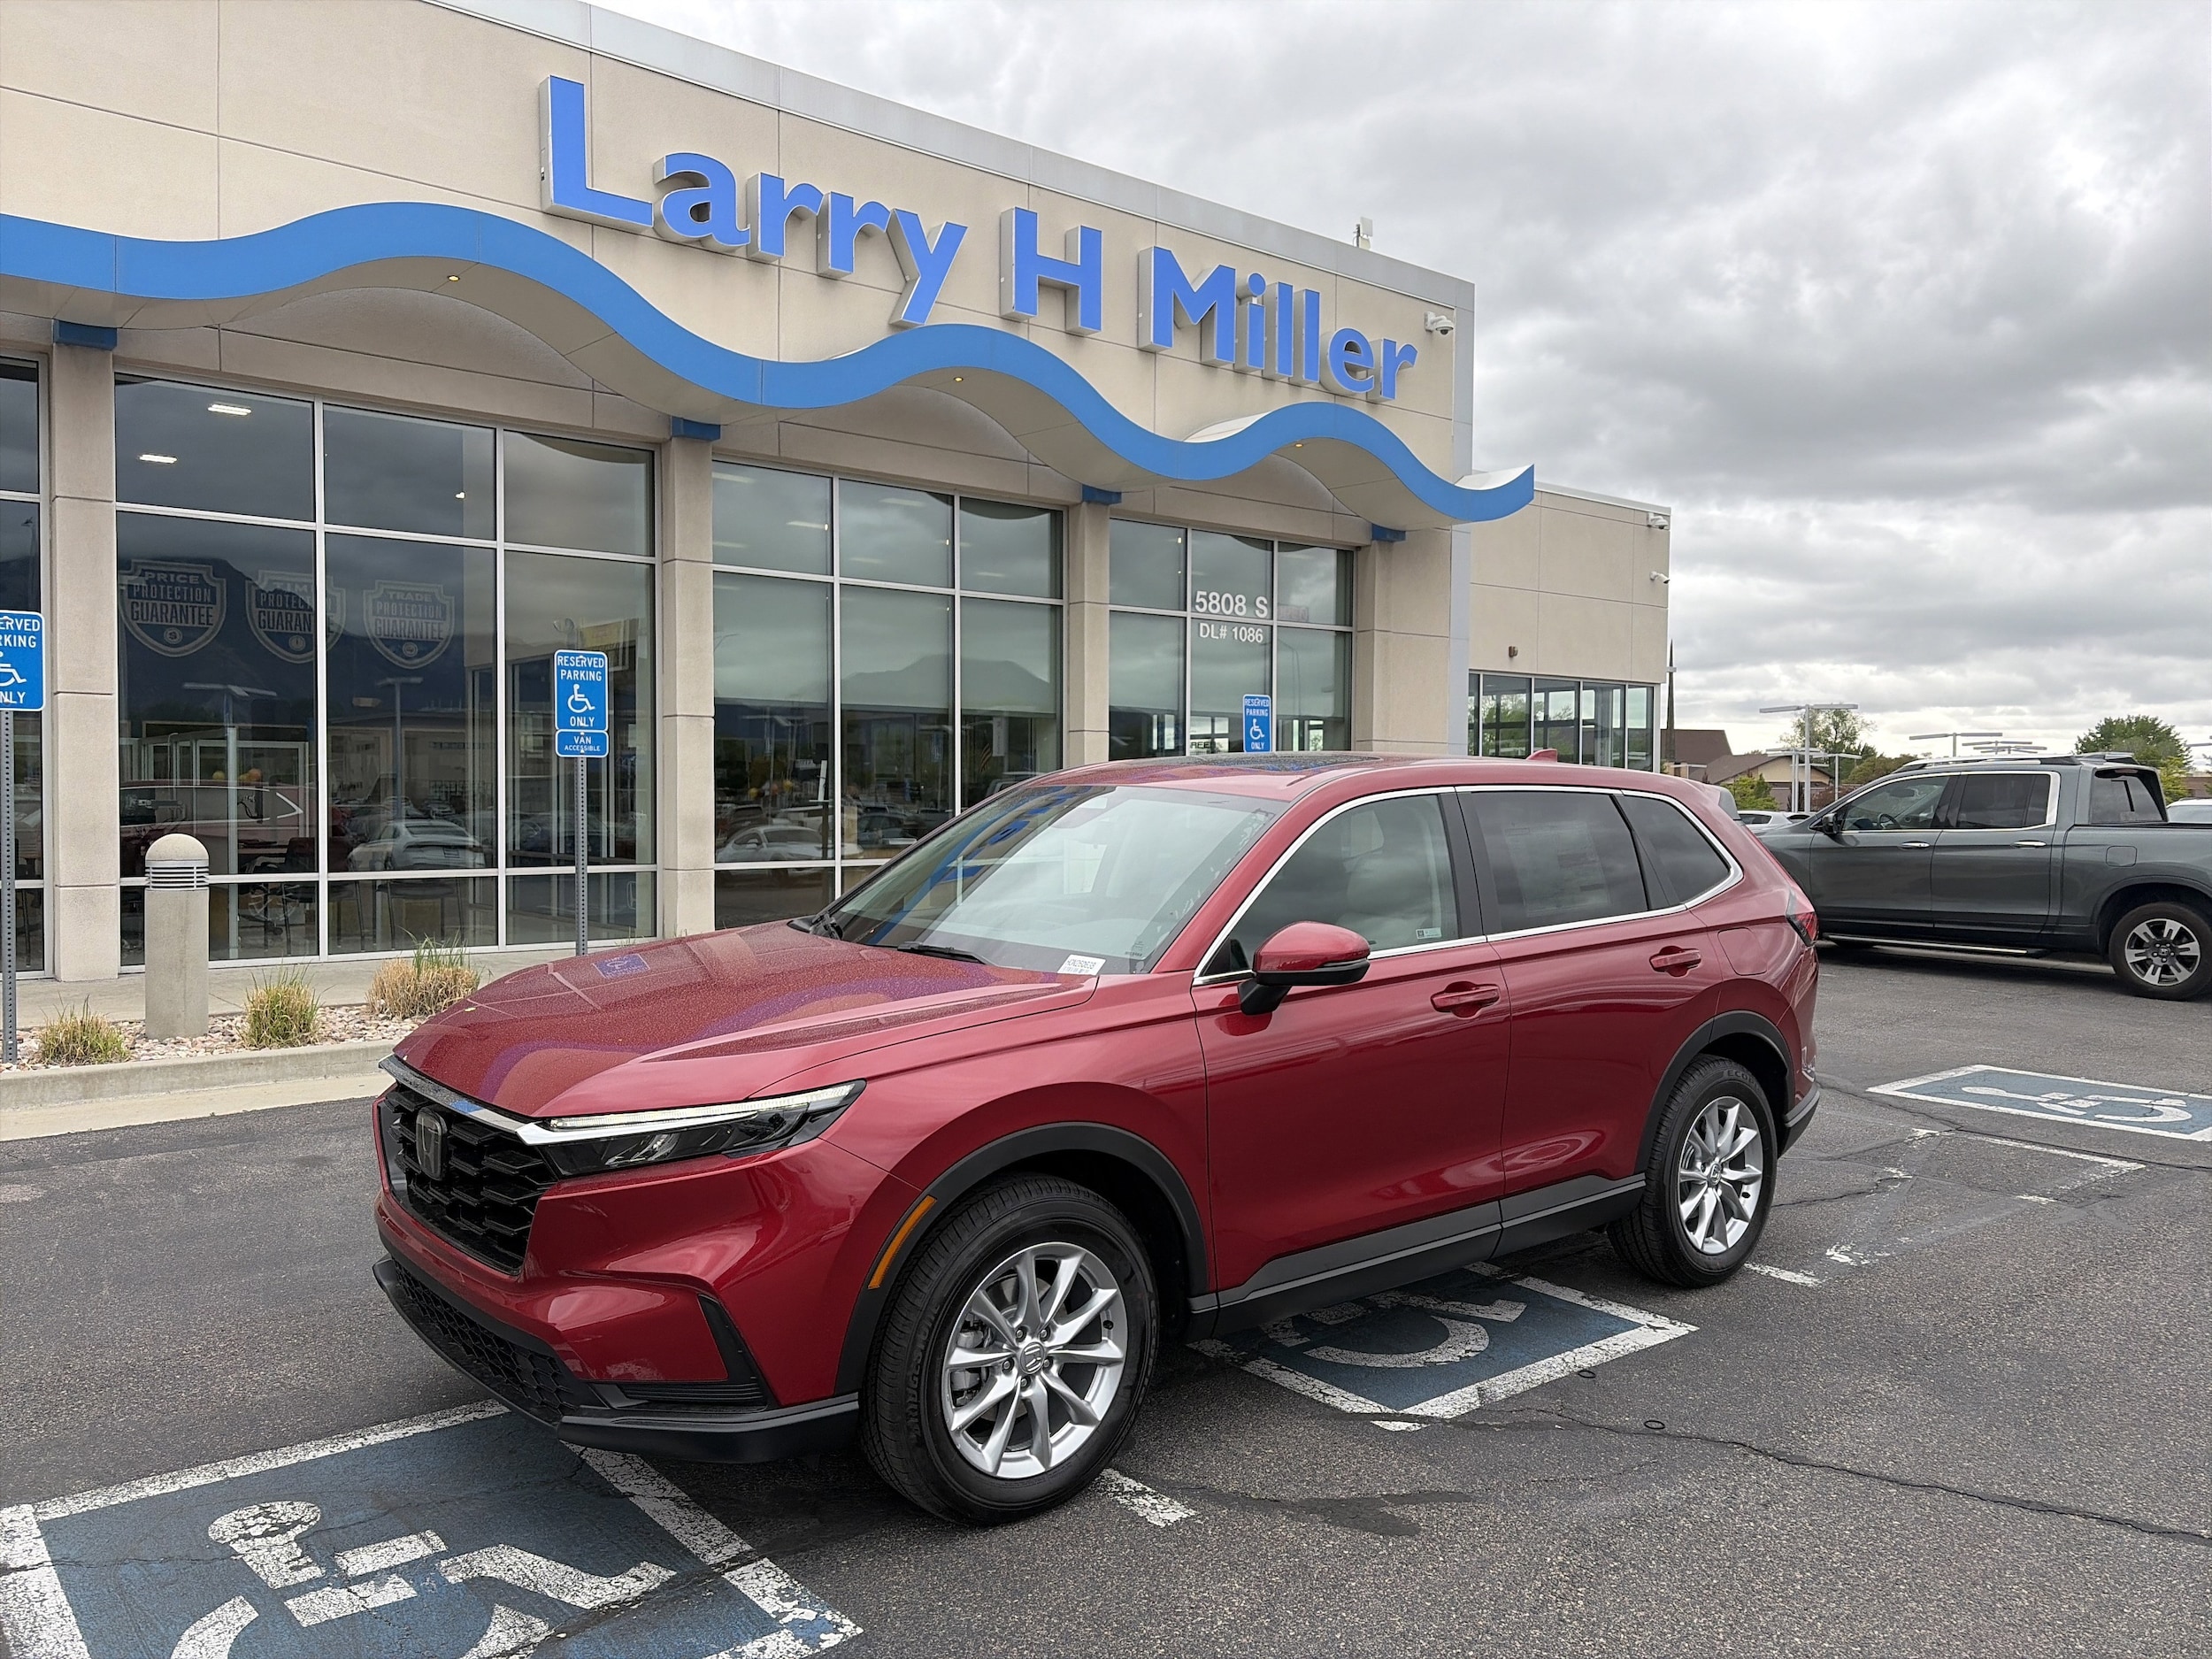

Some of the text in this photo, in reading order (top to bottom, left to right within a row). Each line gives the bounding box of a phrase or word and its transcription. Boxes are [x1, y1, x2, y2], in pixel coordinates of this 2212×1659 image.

[543, 74, 1418, 403] Larry H Miller
[144, 572, 200, 584] PRICE
[133, 584, 211, 603] PROTECTION
[388, 591, 433, 603] TRADE
[376, 601, 442, 619] PROTECTION
[1194, 590, 1247, 616] 5808
[1255, 595, 1268, 618] S
[130, 601, 214, 626] GUARANTEE
[374, 618, 445, 641] GUARANTEE
[1199, 622, 1263, 643] DL# 1086
[0, 634, 36, 649] KING
[557, 656, 604, 668] RESERVED
[560, 669, 603, 681] PARKING
[1244, 698, 1270, 707] RESERVED
[1246, 708, 1268, 717] PARKING
[570, 716, 595, 726] ONLY
[1250, 741, 1265, 750] ONLY
